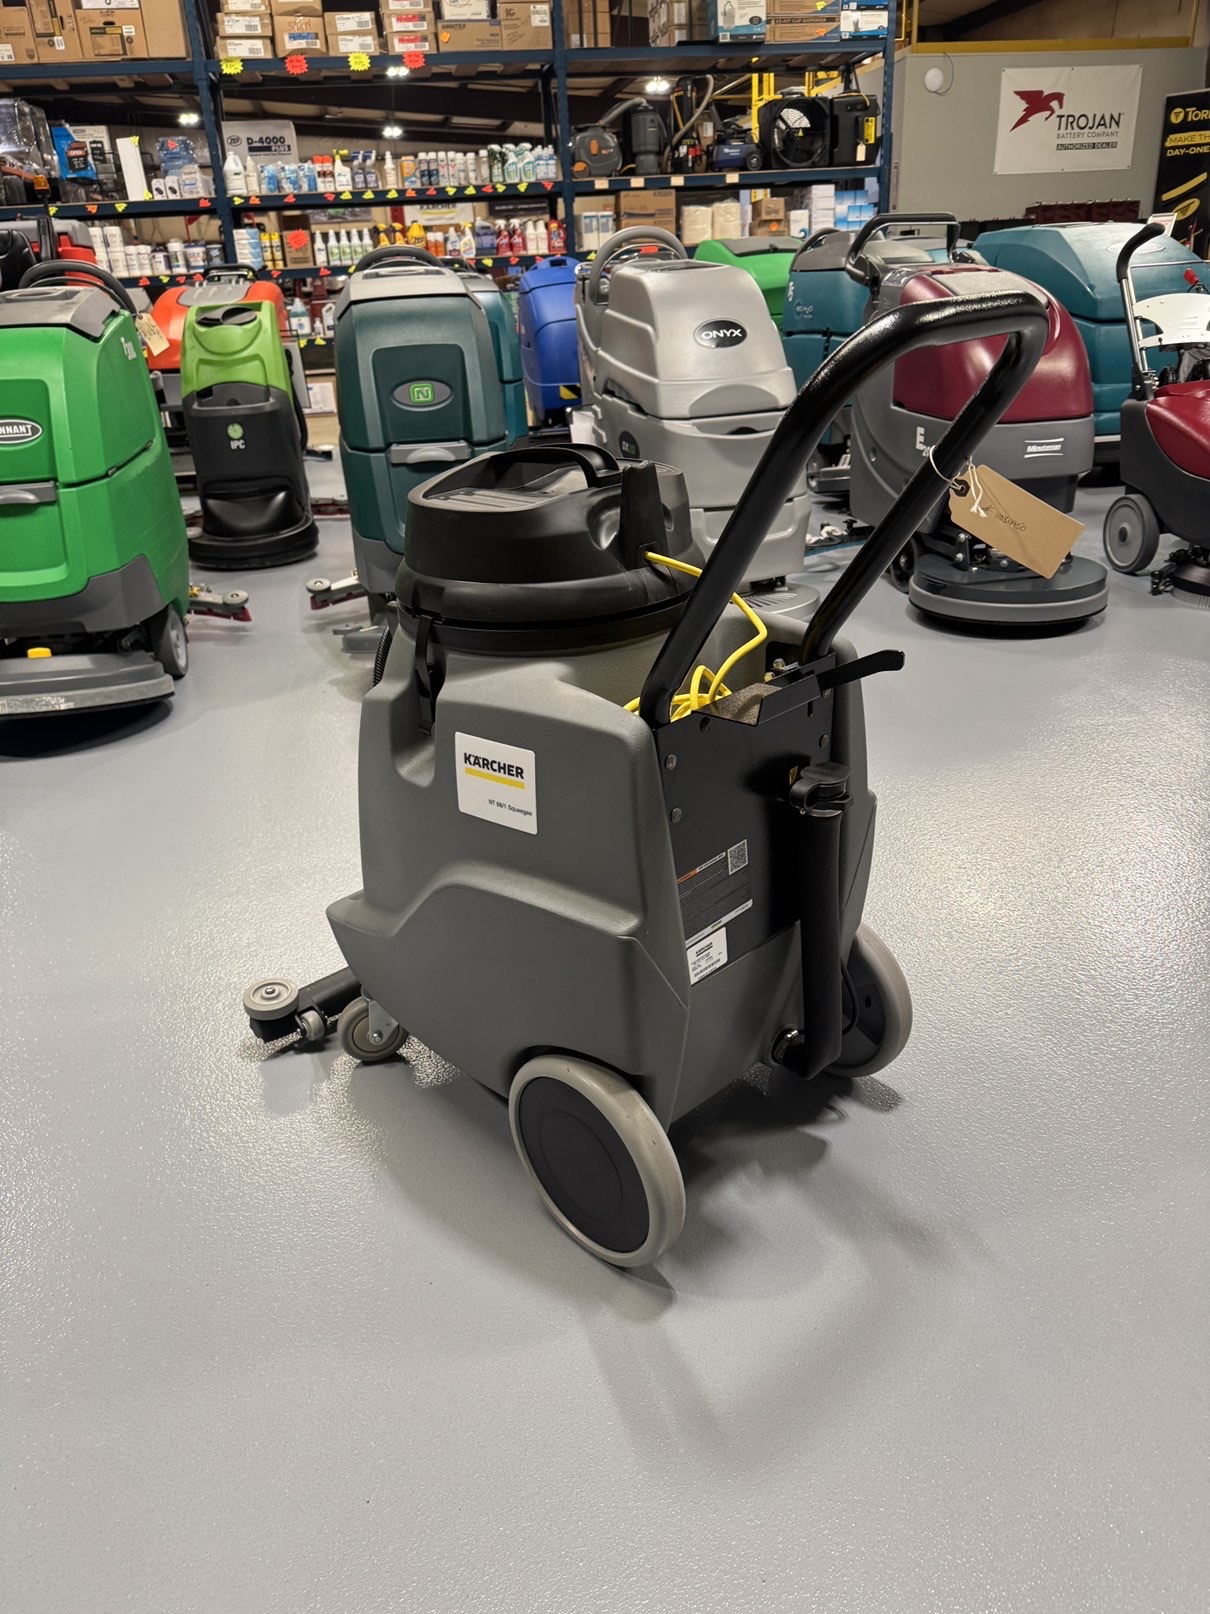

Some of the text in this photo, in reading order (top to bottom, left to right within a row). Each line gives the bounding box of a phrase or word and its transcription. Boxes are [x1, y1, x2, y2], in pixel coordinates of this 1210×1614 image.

[1185, 107, 1210, 121] TOR
[1056, 112, 1121, 131] TROJAN
[246, 136, 285, 145] D-4000
[1057, 130, 1119, 140] BATTERY COMPANY
[1169, 134, 1196, 144] MAKE
[701, 328, 742, 339] ONYX
[230, 439, 246, 450] IPC
[463, 752, 525, 780] KÄRCHER
[507, 804, 533, 816] Squeegee
